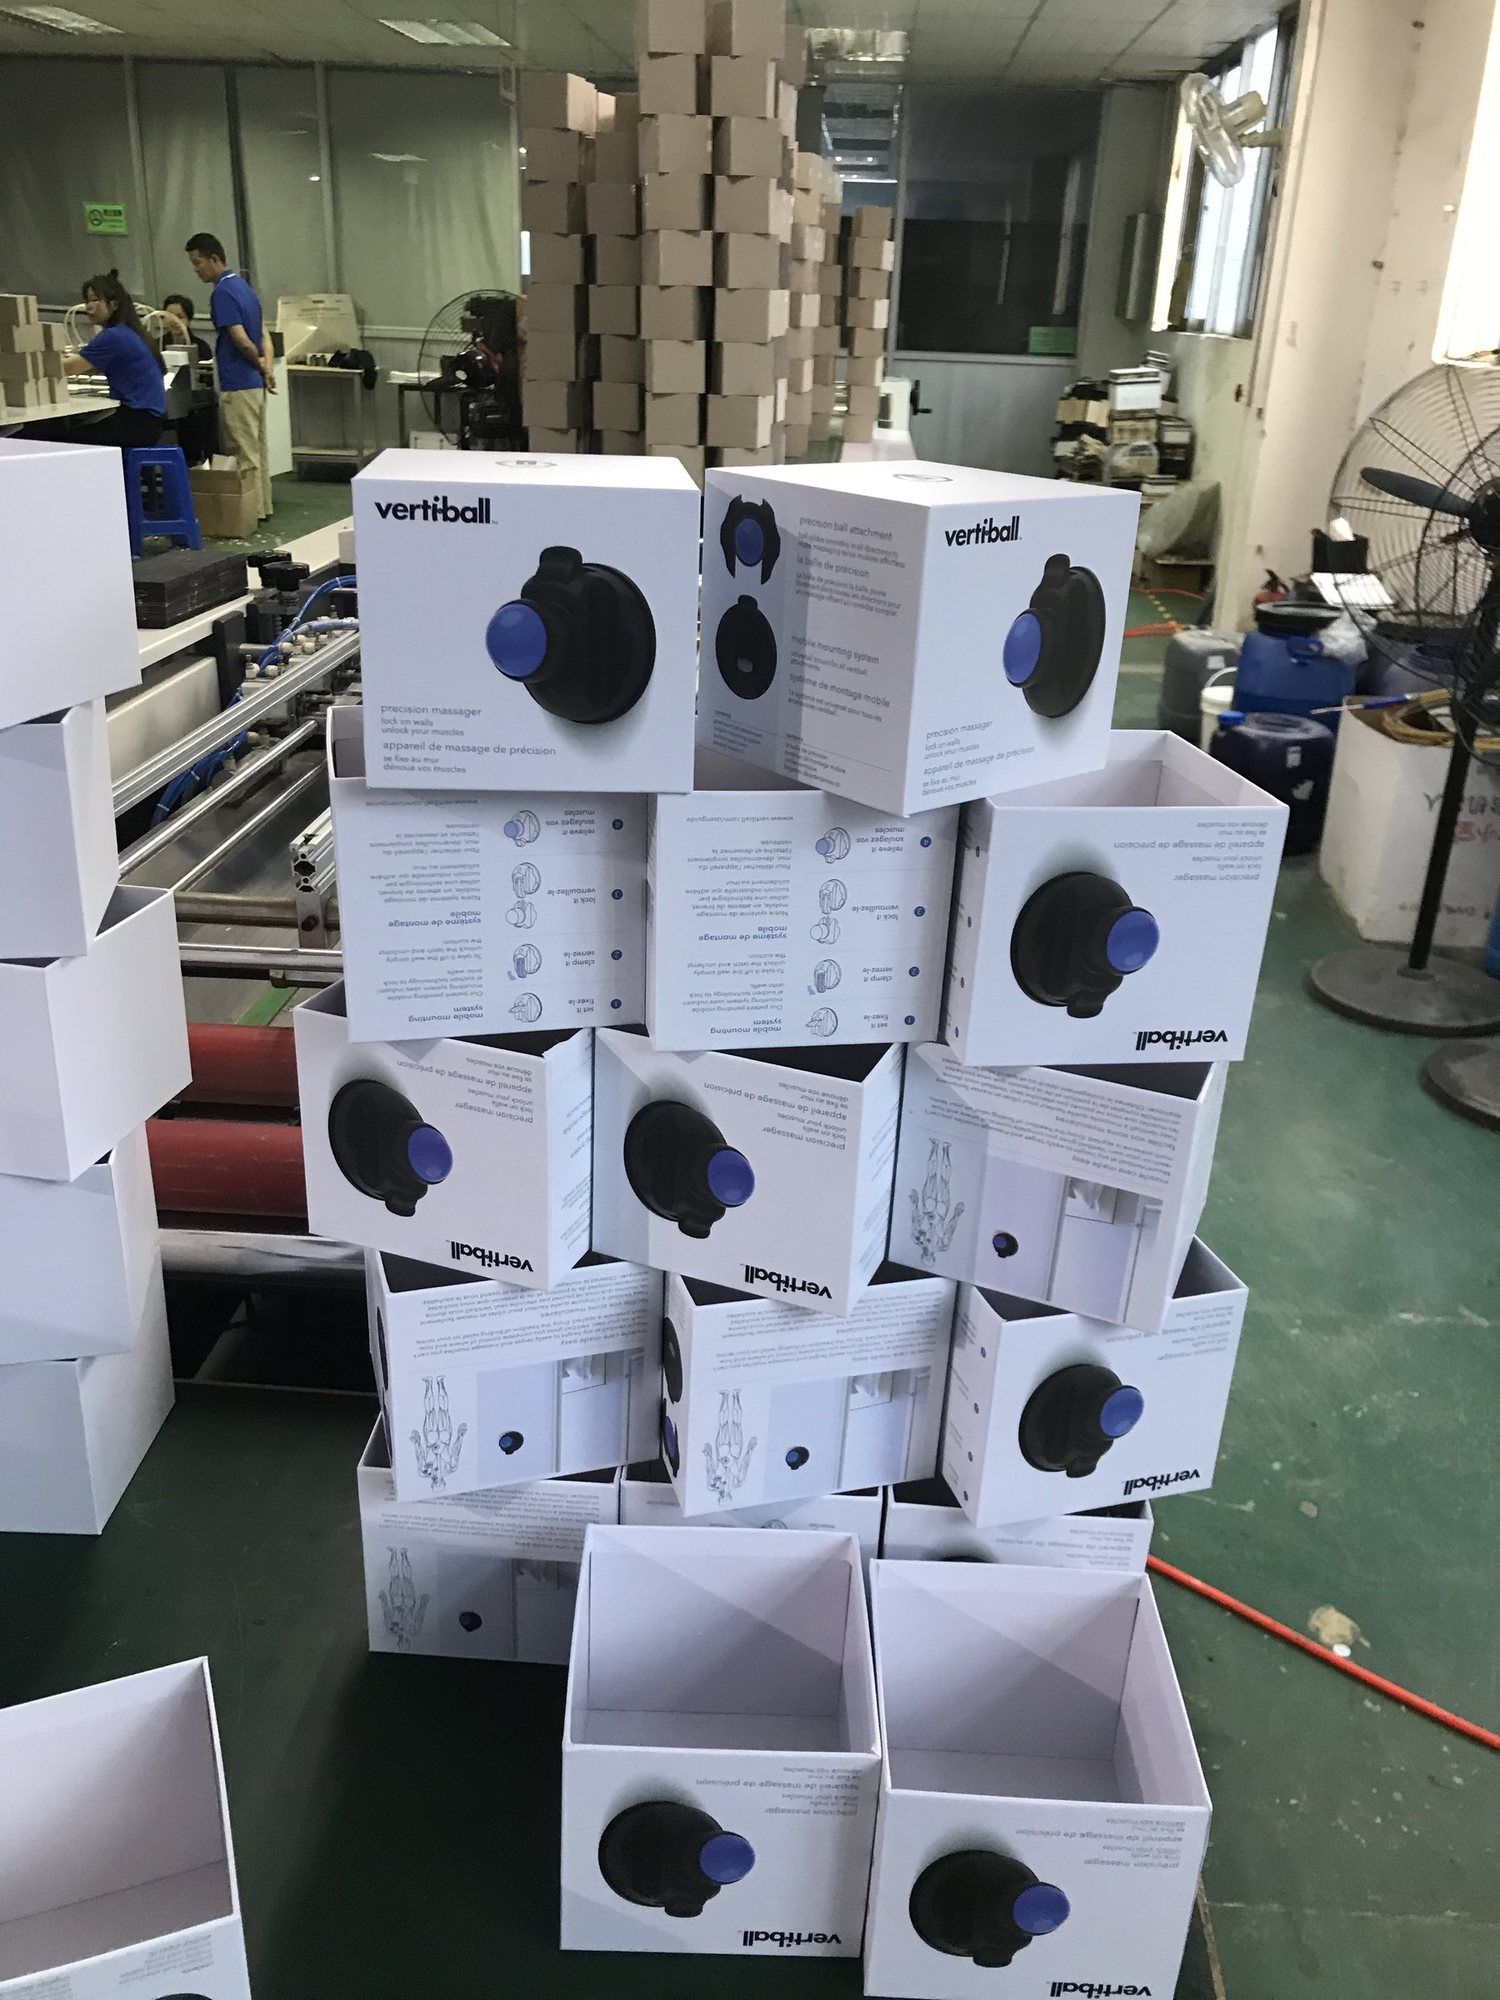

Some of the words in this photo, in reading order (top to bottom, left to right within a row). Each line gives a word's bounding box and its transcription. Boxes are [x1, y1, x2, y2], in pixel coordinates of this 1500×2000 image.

[381, 704, 428, 714] precision
[432, 707, 481, 718] massager
[414, 718, 433, 726] walls
[432, 728, 464, 736] muscles
[926, 727, 958, 740] precision
[961, 721, 993, 732] massager
[383, 741, 425, 751] appareil
[429, 742, 441, 751] de
[445, 745, 489, 755] massage
[493, 745, 506, 753] de
[509, 745, 556, 756] précision
[954, 761, 963, 769] de
[965, 755, 994, 765] massage
[434, 765, 466, 773] muscles
[561, 819, 595, 827] soulagez
[871, 836, 904, 844] soulagez
[1173, 840, 1212, 848] massage
[1158, 841, 1170, 849] de
[1215, 841, 1226, 849] de
[1228, 840, 1265, 849] appareil
[1174, 873, 1217, 881] massager
[1219, 874, 1260, 882] precision
[445, 918, 481, 926] système
[753, 932, 787, 940] système
[453, 1004, 483, 1013] system
[453, 1013, 483, 1021] mobile
[753, 1017, 781, 1025] system
[753, 1026, 781, 1034] mobile
[397, 1060, 433, 1074] précision
[435, 1068, 446, 1076] de
[448, 1071, 483, 1084] massage
[485, 1079, 496, 1087] de
[499, 1082, 532, 1094] appareil
[704, 1082, 742, 1098] précision
[779, 1082, 806, 1094] muscles
[808, 1088, 819, 1096] vos
[468, 1089, 494, 1099] muscles
[744, 1092, 755, 1101] de
[800, 1094, 814, 1102] mur
[758, 1094, 795, 1109] massage
[826, 1100, 838, 1109] fixe
[455, 1102, 494, 1115] massager
[520, 1106, 533, 1114] lock
[797, 1104, 808, 1113] de
[496, 1111, 533, 1123] precision
[811, 1108, 847, 1121] appareil
[777, 1113, 805, 1125] muscles
[807, 1120, 822, 1128] your
[802, 1126, 819, 1134] walls
[824, 1124, 847, 1133] unlock
[762, 1126, 803, 1141] massager
[806, 1137, 846, 1151] precision
[764, 1807, 810, 1815] massager
